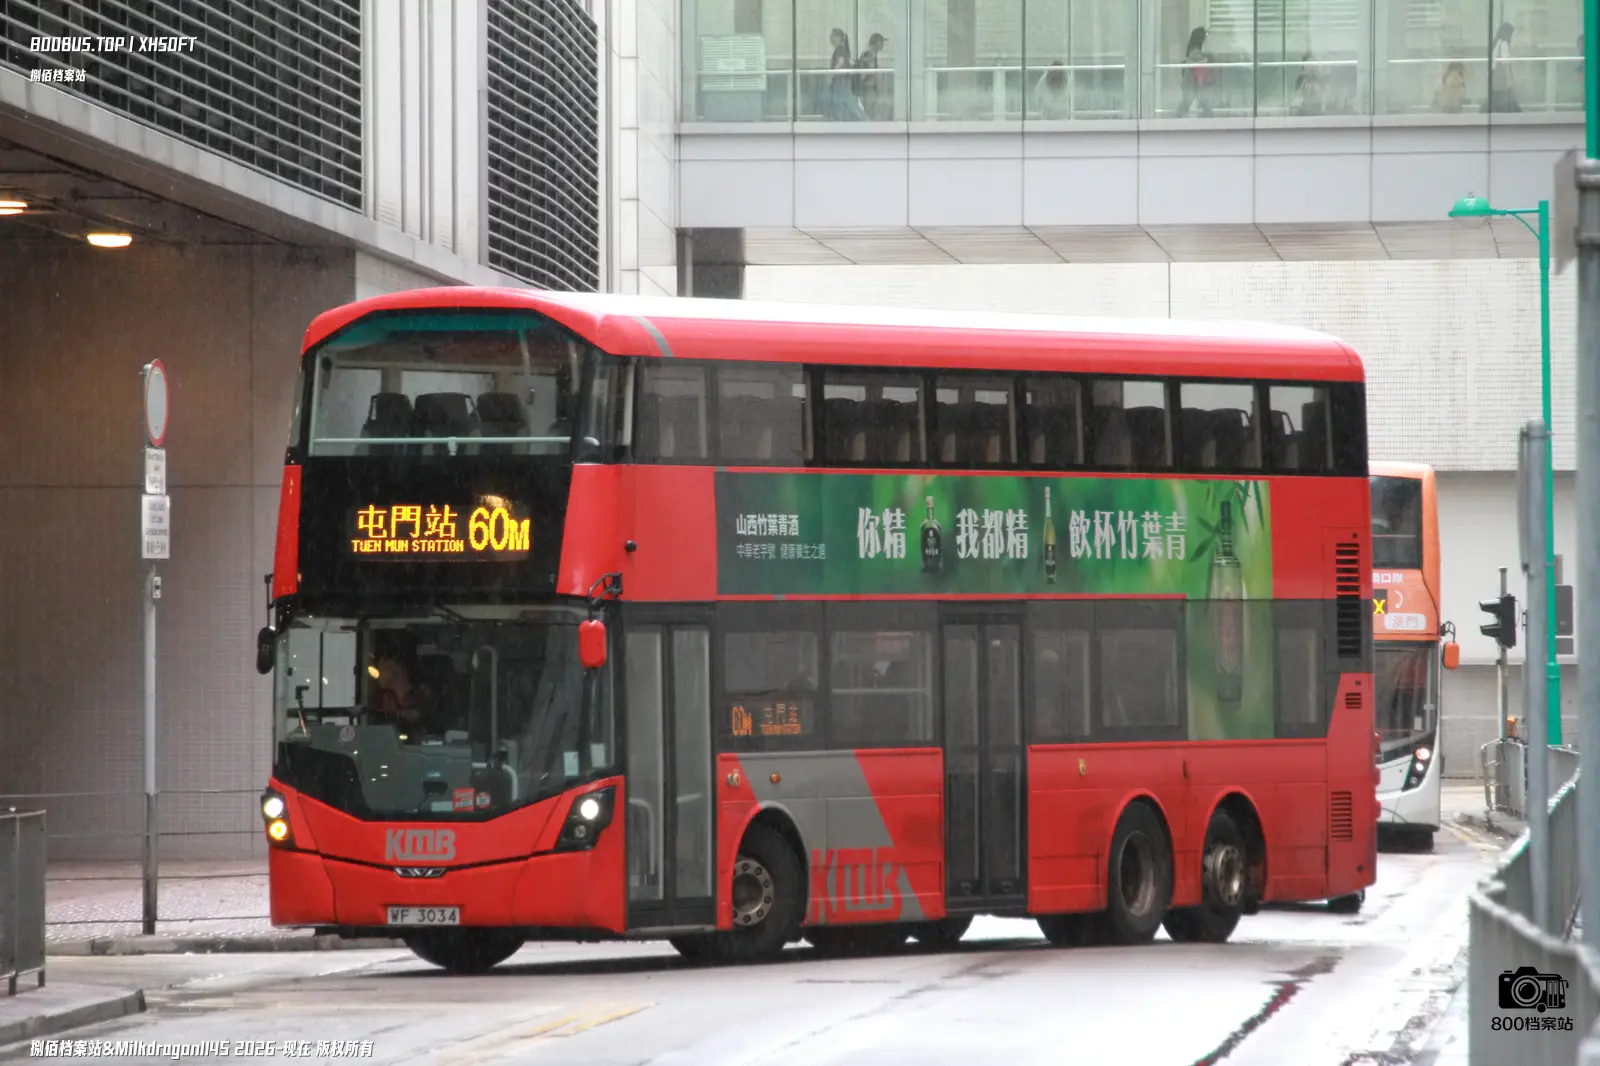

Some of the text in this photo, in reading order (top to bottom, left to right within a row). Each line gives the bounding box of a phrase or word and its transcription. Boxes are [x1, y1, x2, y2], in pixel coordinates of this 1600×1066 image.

[357, 504, 458, 539] 屯門站
[468, 507, 531, 551] 60M
[736, 513, 800, 537] 山西竹葉青酒
[856, 507, 1187, 561] 你精 我都精 飲杯竹葉青
[352, 539, 464, 552] TUEN MUN STATION
[385, 828, 456, 861] KMB
[811, 847, 903, 925] KMB
[390, 909, 459, 923] WF 3034
